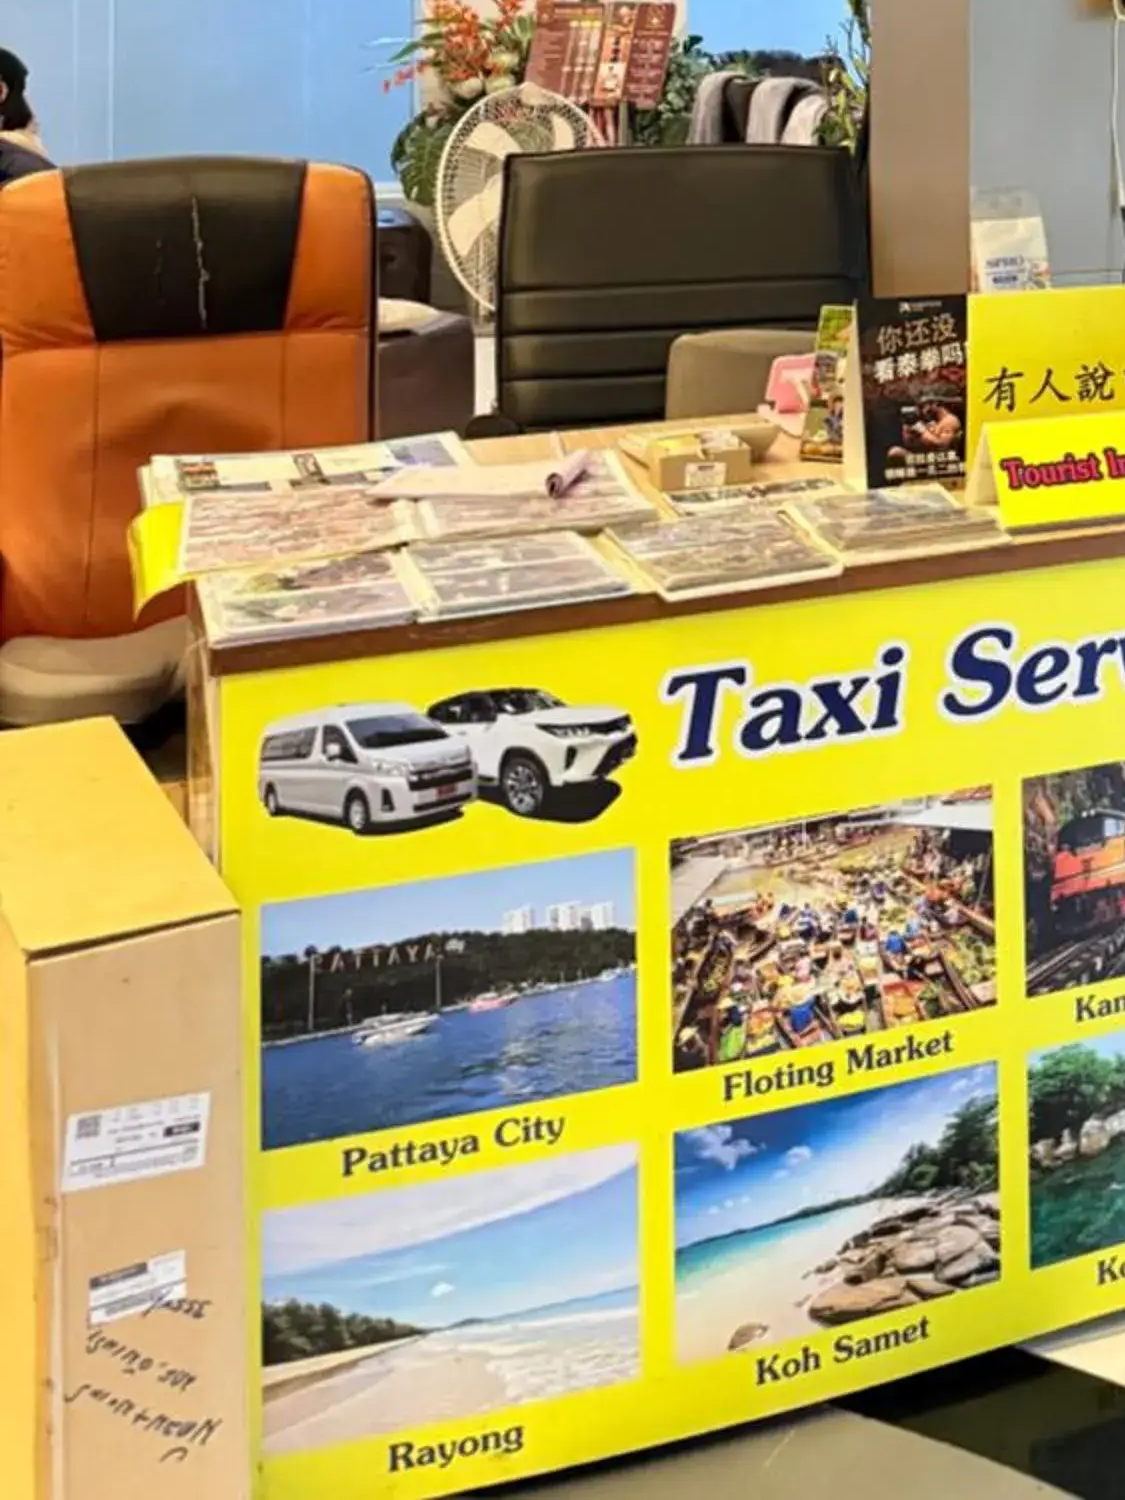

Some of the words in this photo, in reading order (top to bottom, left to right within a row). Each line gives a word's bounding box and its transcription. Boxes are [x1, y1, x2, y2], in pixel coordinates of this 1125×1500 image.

[1002, 452, 1103, 490] Tourist
[667, 645, 905, 760] Taxi
[723, 1059, 834, 1101] Floting
[846, 1030, 955, 1077] Market
[342, 1133, 481, 1178] Pattaya
[494, 1115, 566, 1148] City
[755, 1350, 821, 1387] Koh
[833, 1316, 932, 1364] Samet
[387, 1424, 525, 1474] Rayong
